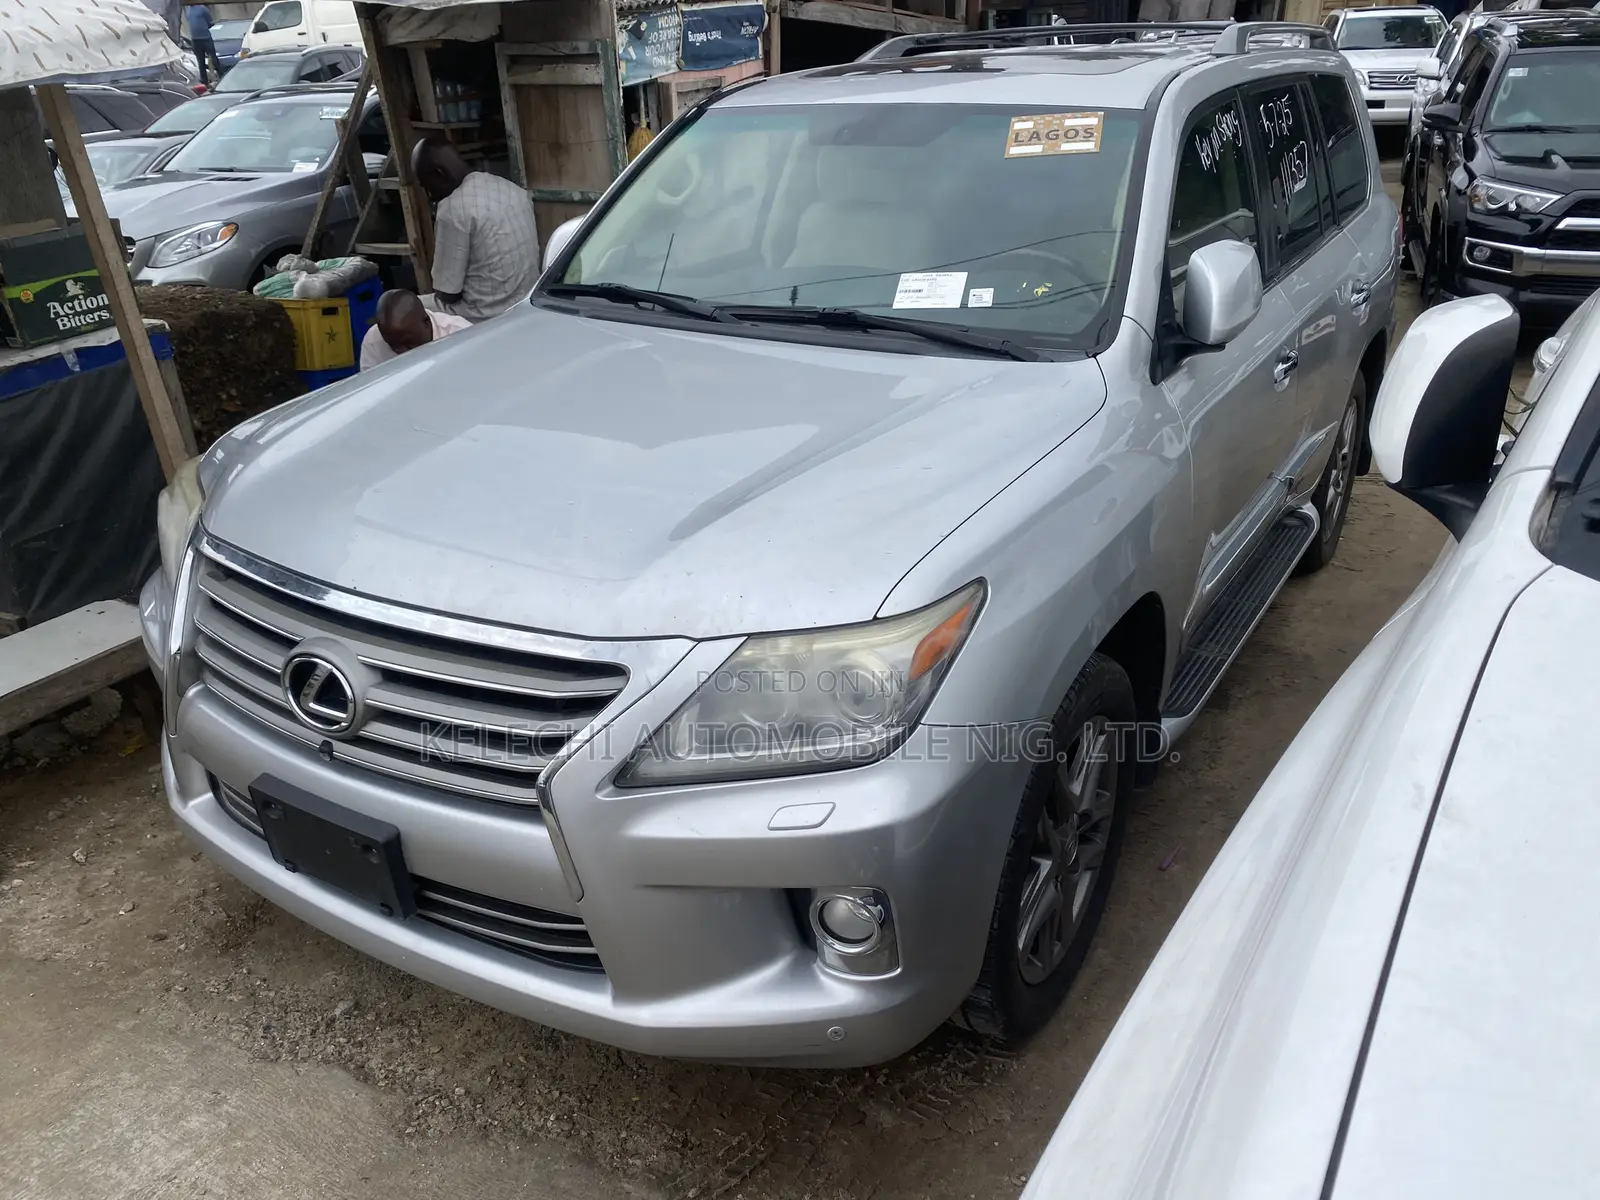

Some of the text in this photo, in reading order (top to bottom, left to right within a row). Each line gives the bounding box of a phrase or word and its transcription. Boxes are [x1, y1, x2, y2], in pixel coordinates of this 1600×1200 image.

[1013, 128, 1095, 143] LAGOS
[46, 293, 109, 318] Action
[56, 309, 110, 330] Bitters
